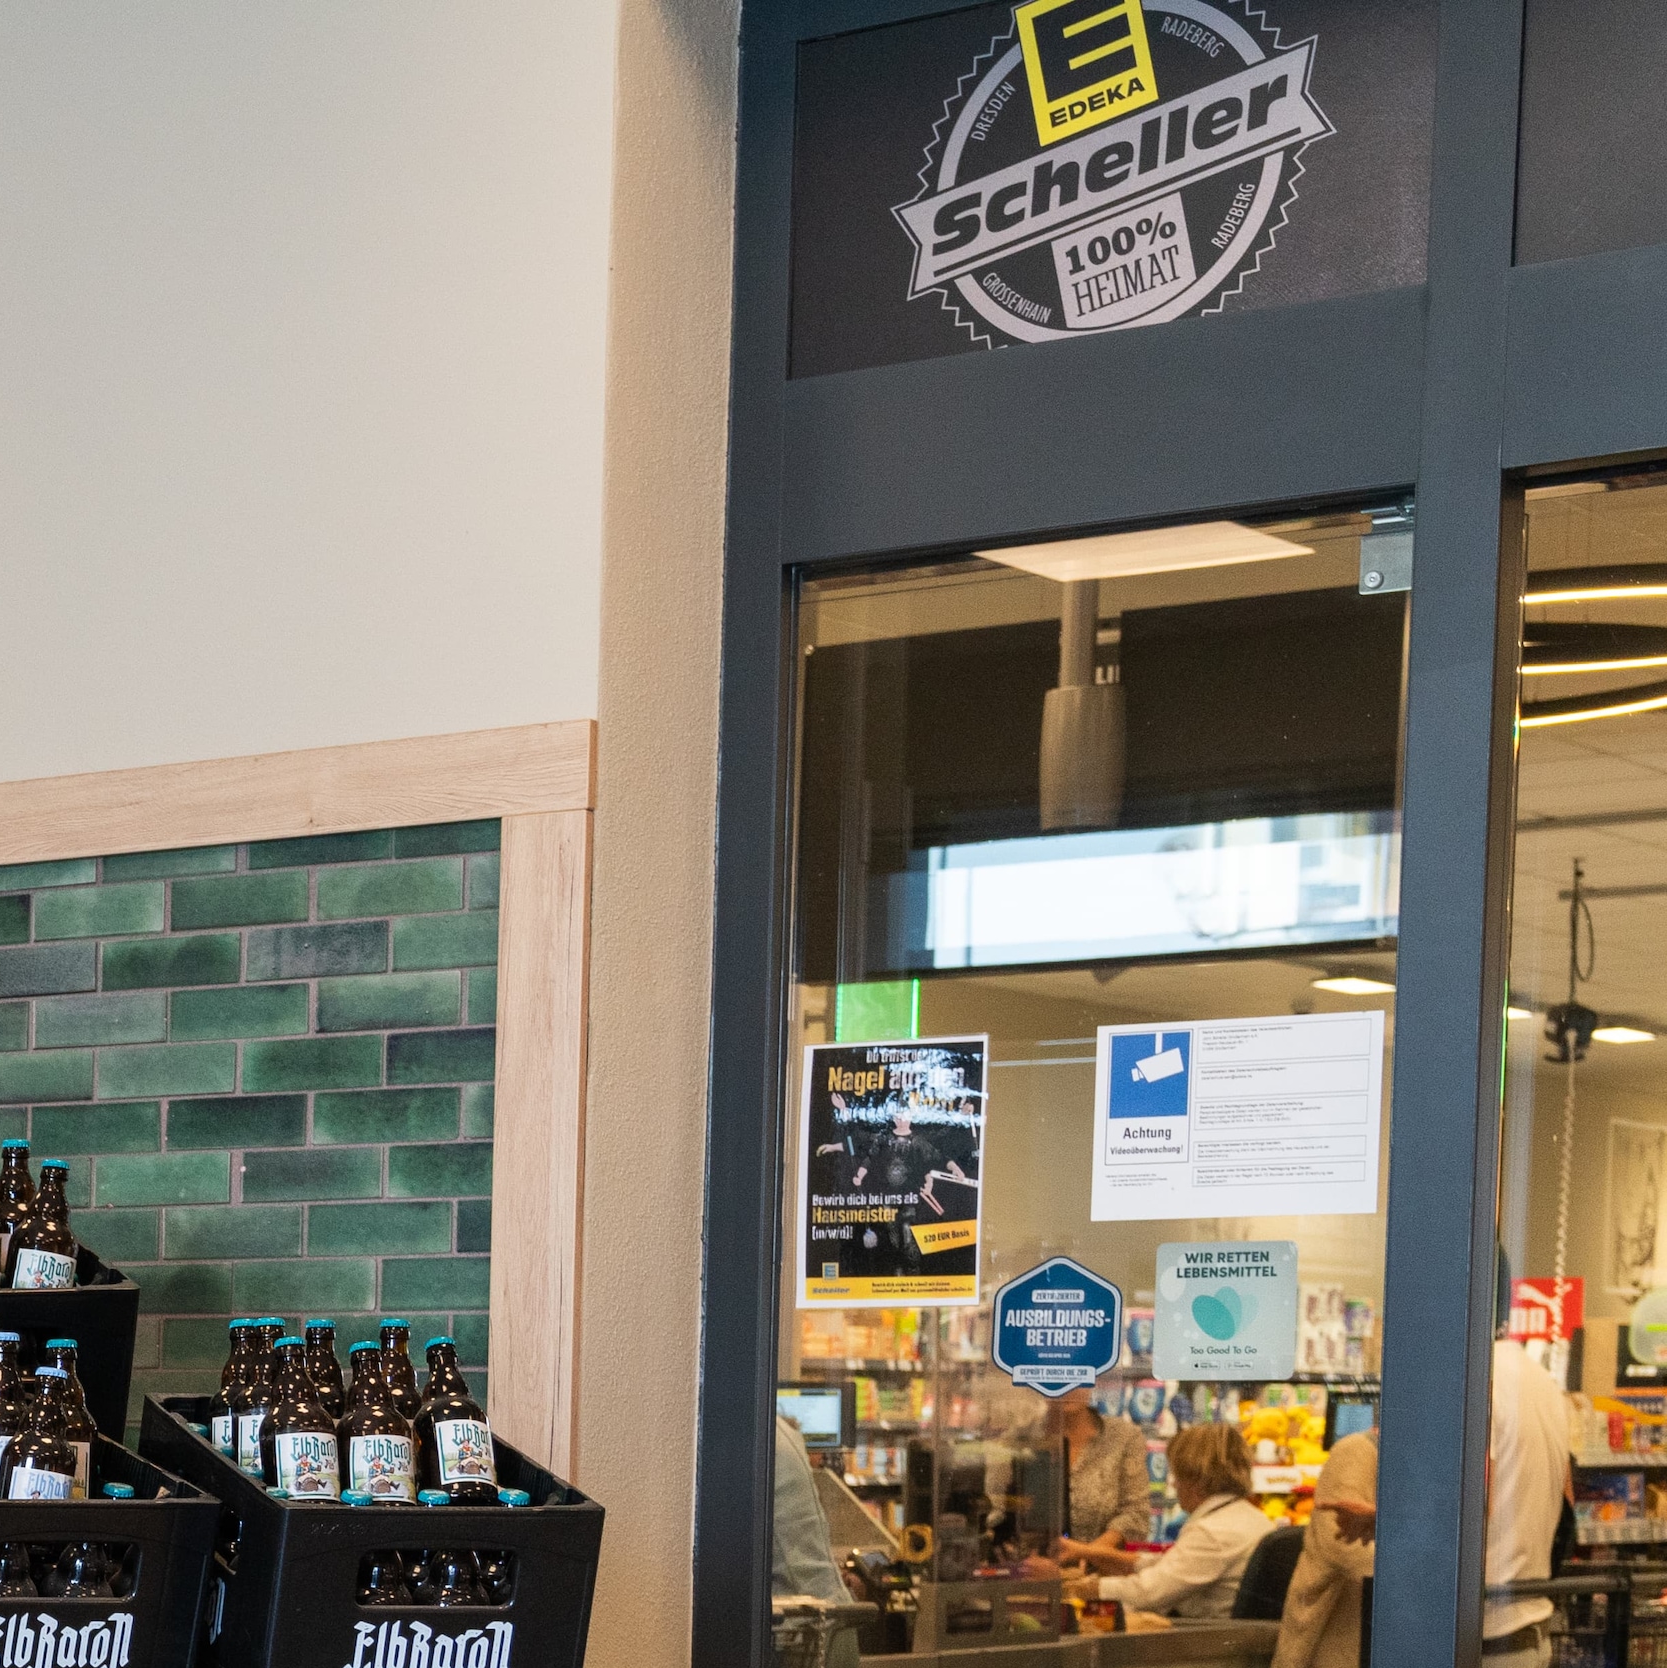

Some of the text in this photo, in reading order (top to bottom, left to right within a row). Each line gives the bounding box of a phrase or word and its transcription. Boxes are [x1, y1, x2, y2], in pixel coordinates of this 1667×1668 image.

[1160, 16, 1226, 58] RADEBERG
[971, 81, 1017, 142] DRESDEN
[1048, 76, 1146, 128] EDEKA
[931, 72, 1289, 258] Scheller
[1211, 182, 1256, 250] RADEBERG
[1065, 212, 1178, 276] 100%
[1071, 245, 1181, 318] HEIMAT
[981, 271, 1052, 324] GROSSENHAIN
[828, 1066, 885, 1096] Nagel
[1123, 1127, 1172, 1140] Achtung
[1110, 1145, 1184, 1157] Videoüberwachung!
[812, 1192, 919, 1206] Bewirb dich bei uns als
[812, 1206, 898, 1223] Hausmeister
[924, 1229, 970, 1243] 520 EUR Basis
[1185, 1251, 1269, 1263] WIR RETTEN
[1177, 1266, 1278, 1279] LEBENSMITTEL
[1005, 1309, 1111, 1328] AUSBILDUNGS-
[1026, 1329, 1087, 1346] BETRIEB
[1190, 1345, 1257, 1354] Too Good To Go
